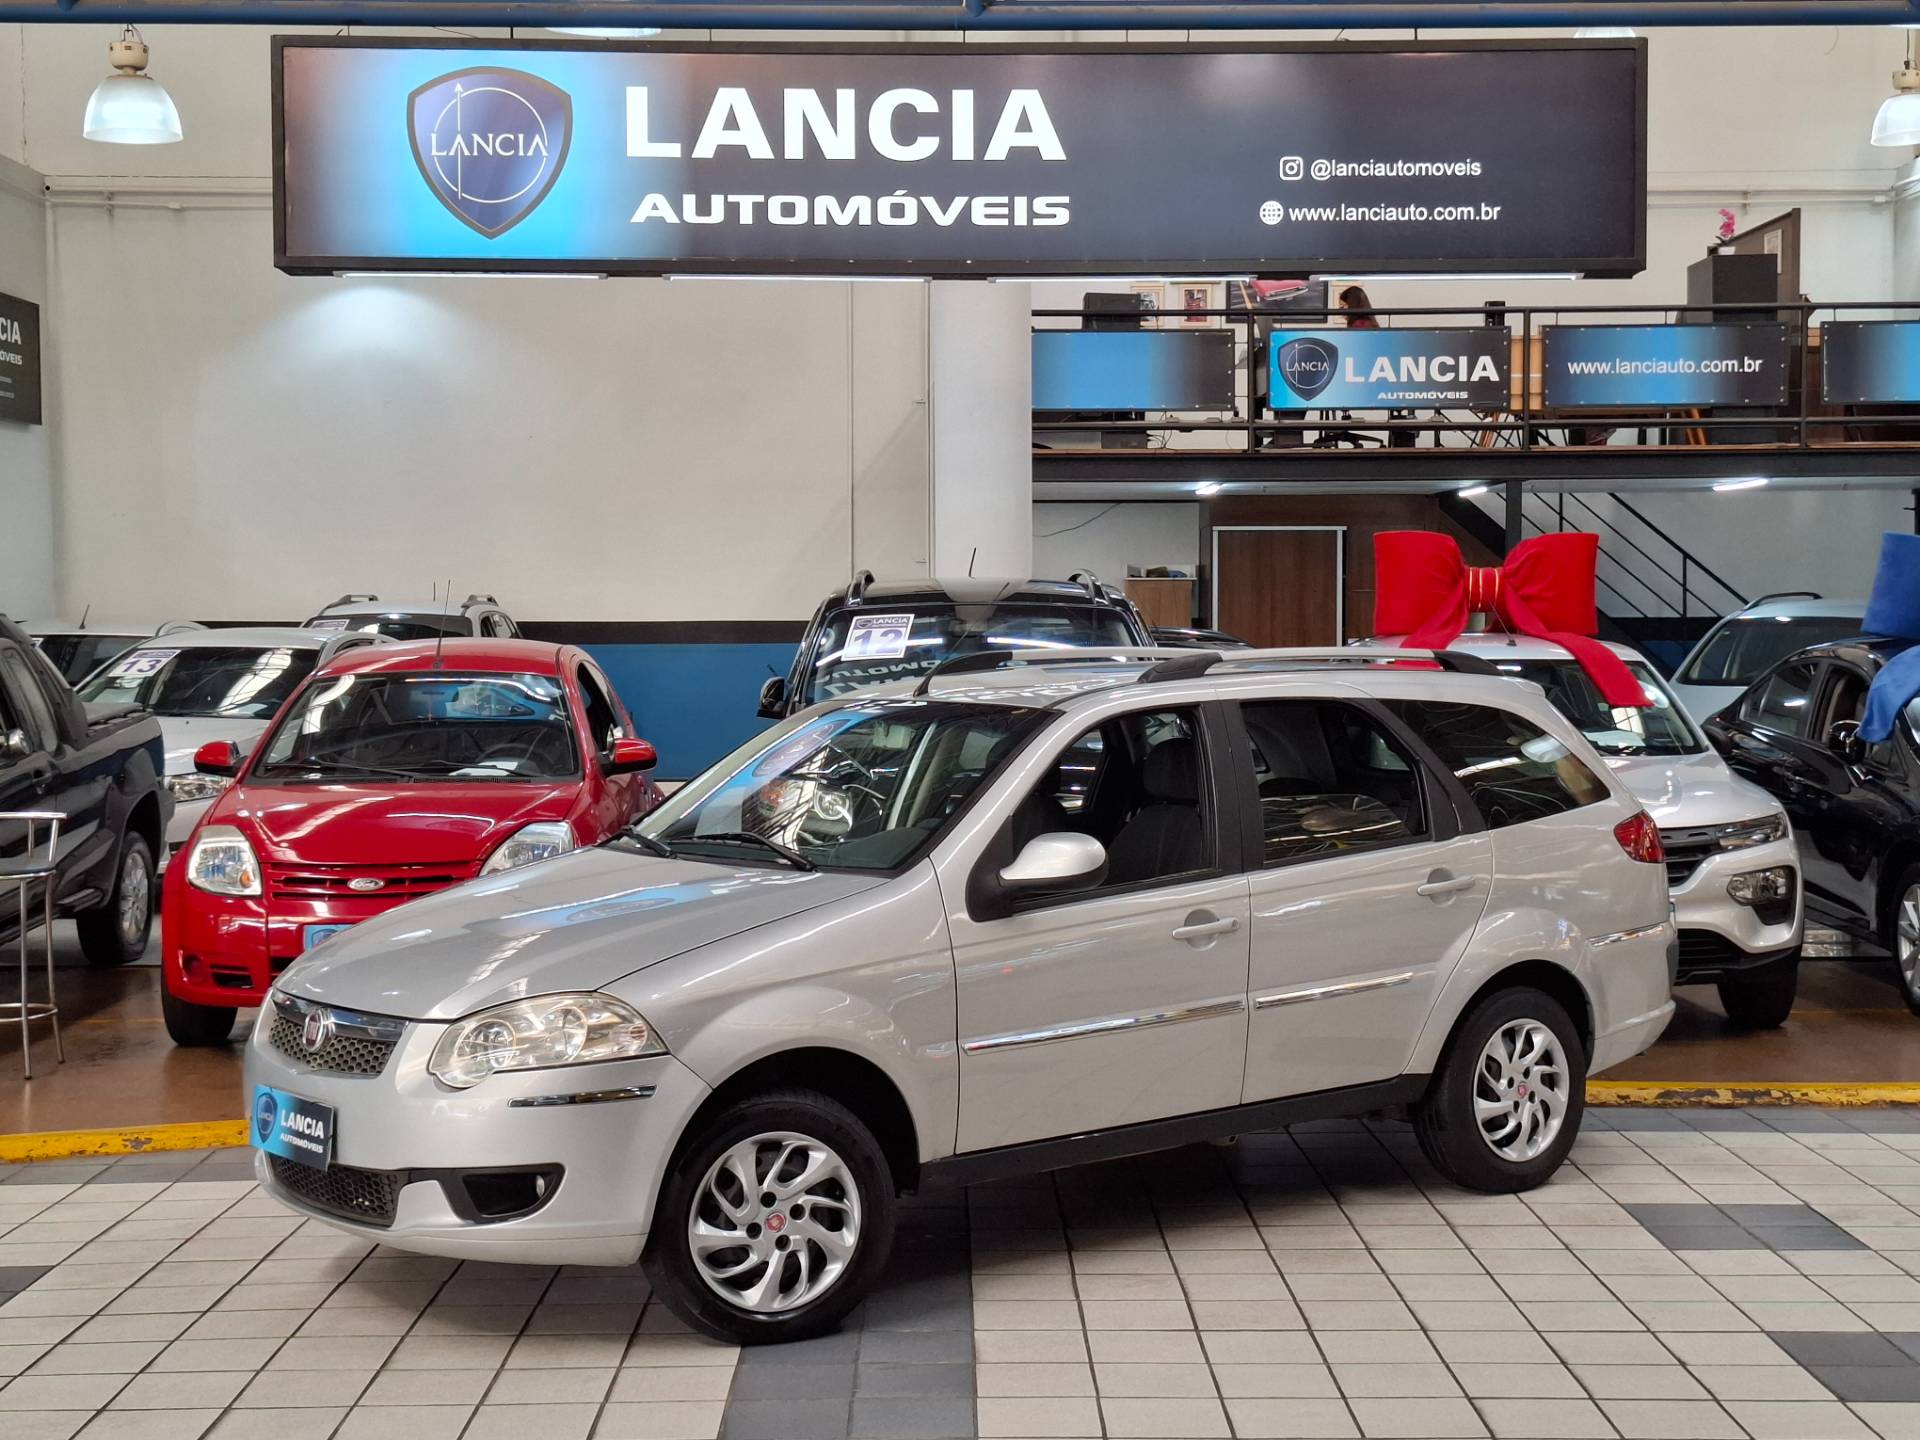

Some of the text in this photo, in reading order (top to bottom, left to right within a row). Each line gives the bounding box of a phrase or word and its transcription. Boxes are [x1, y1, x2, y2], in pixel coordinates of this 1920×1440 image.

[625, 85, 1067, 162] LANCIA
[430, 132, 549, 156] LANCIA
[1310, 158, 1483, 181] @lanciautomoveis
[630, 189, 1071, 227] AUTOMÓVEIS
[1288, 202, 1502, 222] www.lanciauto.com.br
[1286, 361, 1330, 372] LANCIA
[1345, 355, 1500, 383] LANCIA
[1567, 356, 1763, 375] www.lanciauto.com.br
[1377, 390, 1469, 400] AUTOMÓVEIS
[854, 629, 903, 654] 12
[122, 659, 162, 673] 13
[280, 1109, 324, 1139] LANCIA
